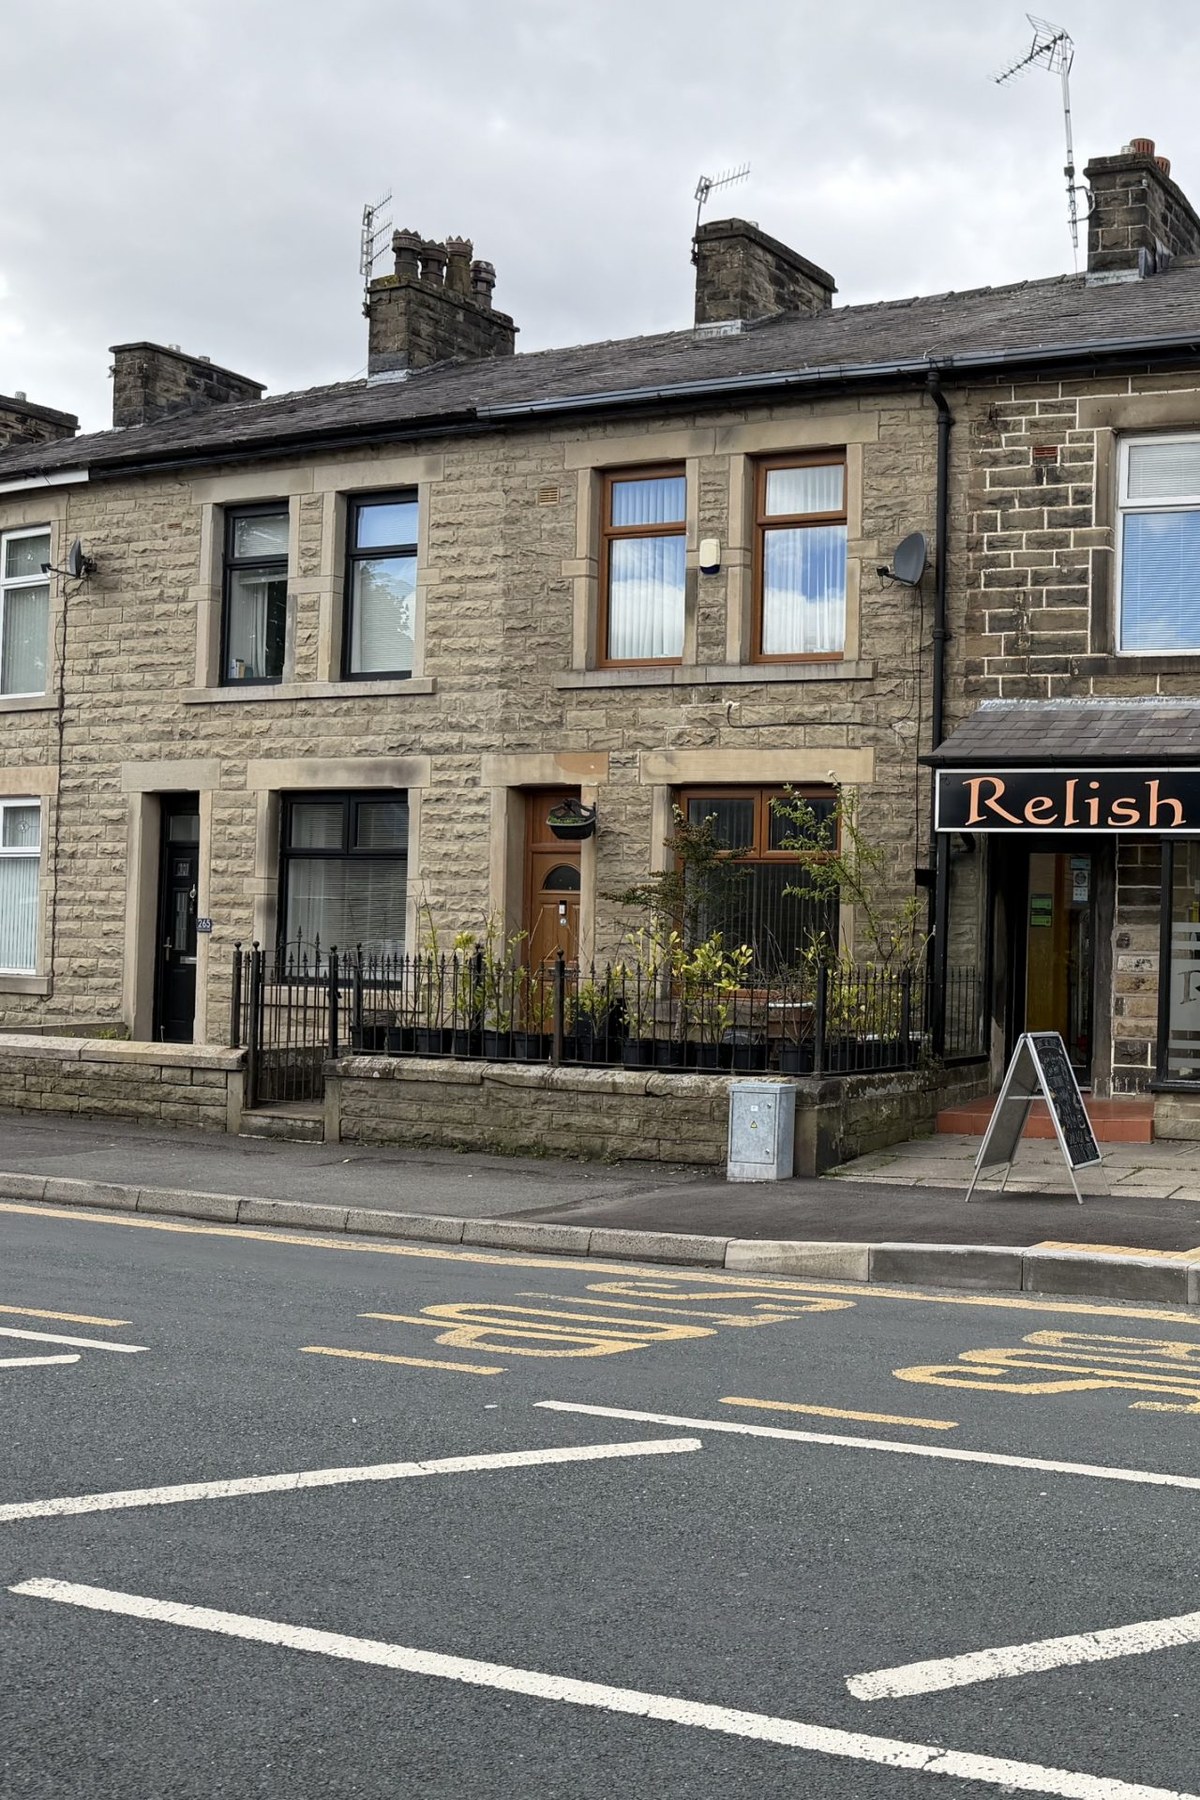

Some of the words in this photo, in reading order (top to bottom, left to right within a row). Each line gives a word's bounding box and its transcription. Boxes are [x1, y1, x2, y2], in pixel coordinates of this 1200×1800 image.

[962, 777, 1186, 827] Relish
[198, 919, 211, 928] 265
[358, 1281, 856, 1358] STOP
